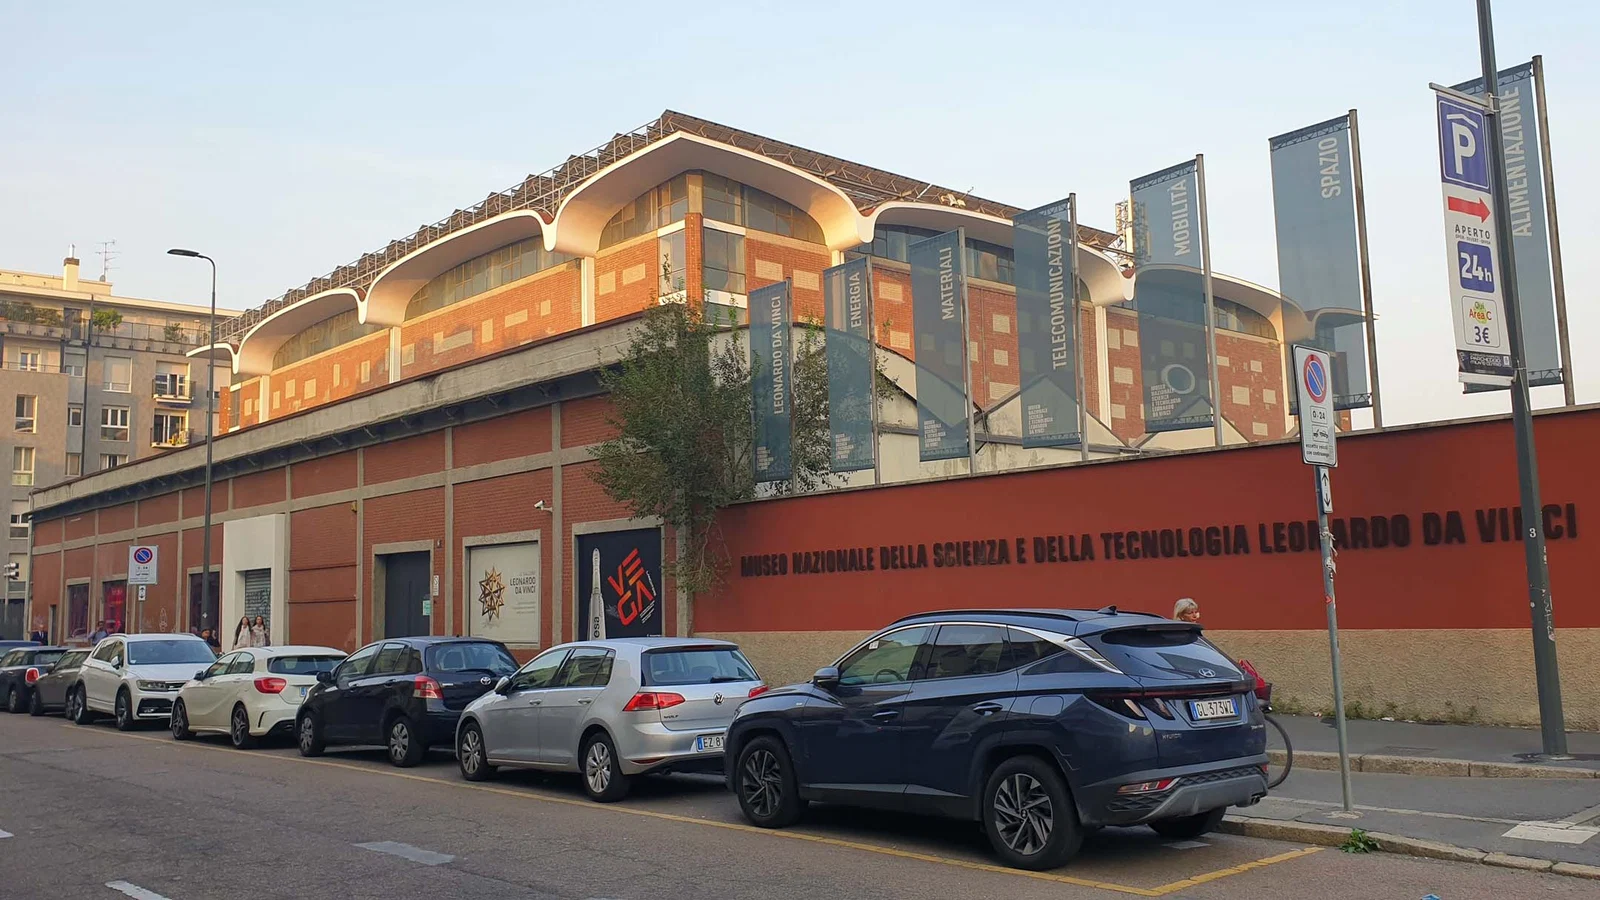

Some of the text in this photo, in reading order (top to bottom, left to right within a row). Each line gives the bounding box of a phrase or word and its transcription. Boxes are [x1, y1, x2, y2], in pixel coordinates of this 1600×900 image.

[1318, 137, 1341, 199] SPAZIO
[1452, 122, 1476, 175] P
[1500, 86, 1532, 237] ALIMENTAZIONE
[1167, 179, 1191, 257] MOBILITÀ
[1455, 224, 1491, 240] APERTO
[939, 247, 955, 320] MATERIALI
[1047, 217, 1067, 370] TELECOMUNICAZIONI
[1460, 252, 1492, 282] 24h
[849, 272, 862, 328] ENERGIA
[1469, 308, 1492, 321] Area C
[771, 296, 784, 415] LEONARDO DA VINCI
[740, 553, 788, 577] MUSEO
[792, 547, 874, 574] NAZIONALE
[880, 543, 928, 570] DELLA
[933, 538, 1011, 568] SCIENZA
[1016, 537, 1027, 564] E
[1033, 533, 1095, 563] DELLA
[1100, 524, 1250, 560] TECNOLOGIA
[1422, 510, 1466, 546] DA
[1529, 528, 1537, 538] 3
[510, 576, 536, 586] LEONARDO
[515, 585, 536, 594] DA VINCI
[1195, 700, 1234, 717] GL 373WZ
[703, 737, 713, 748] EZ
